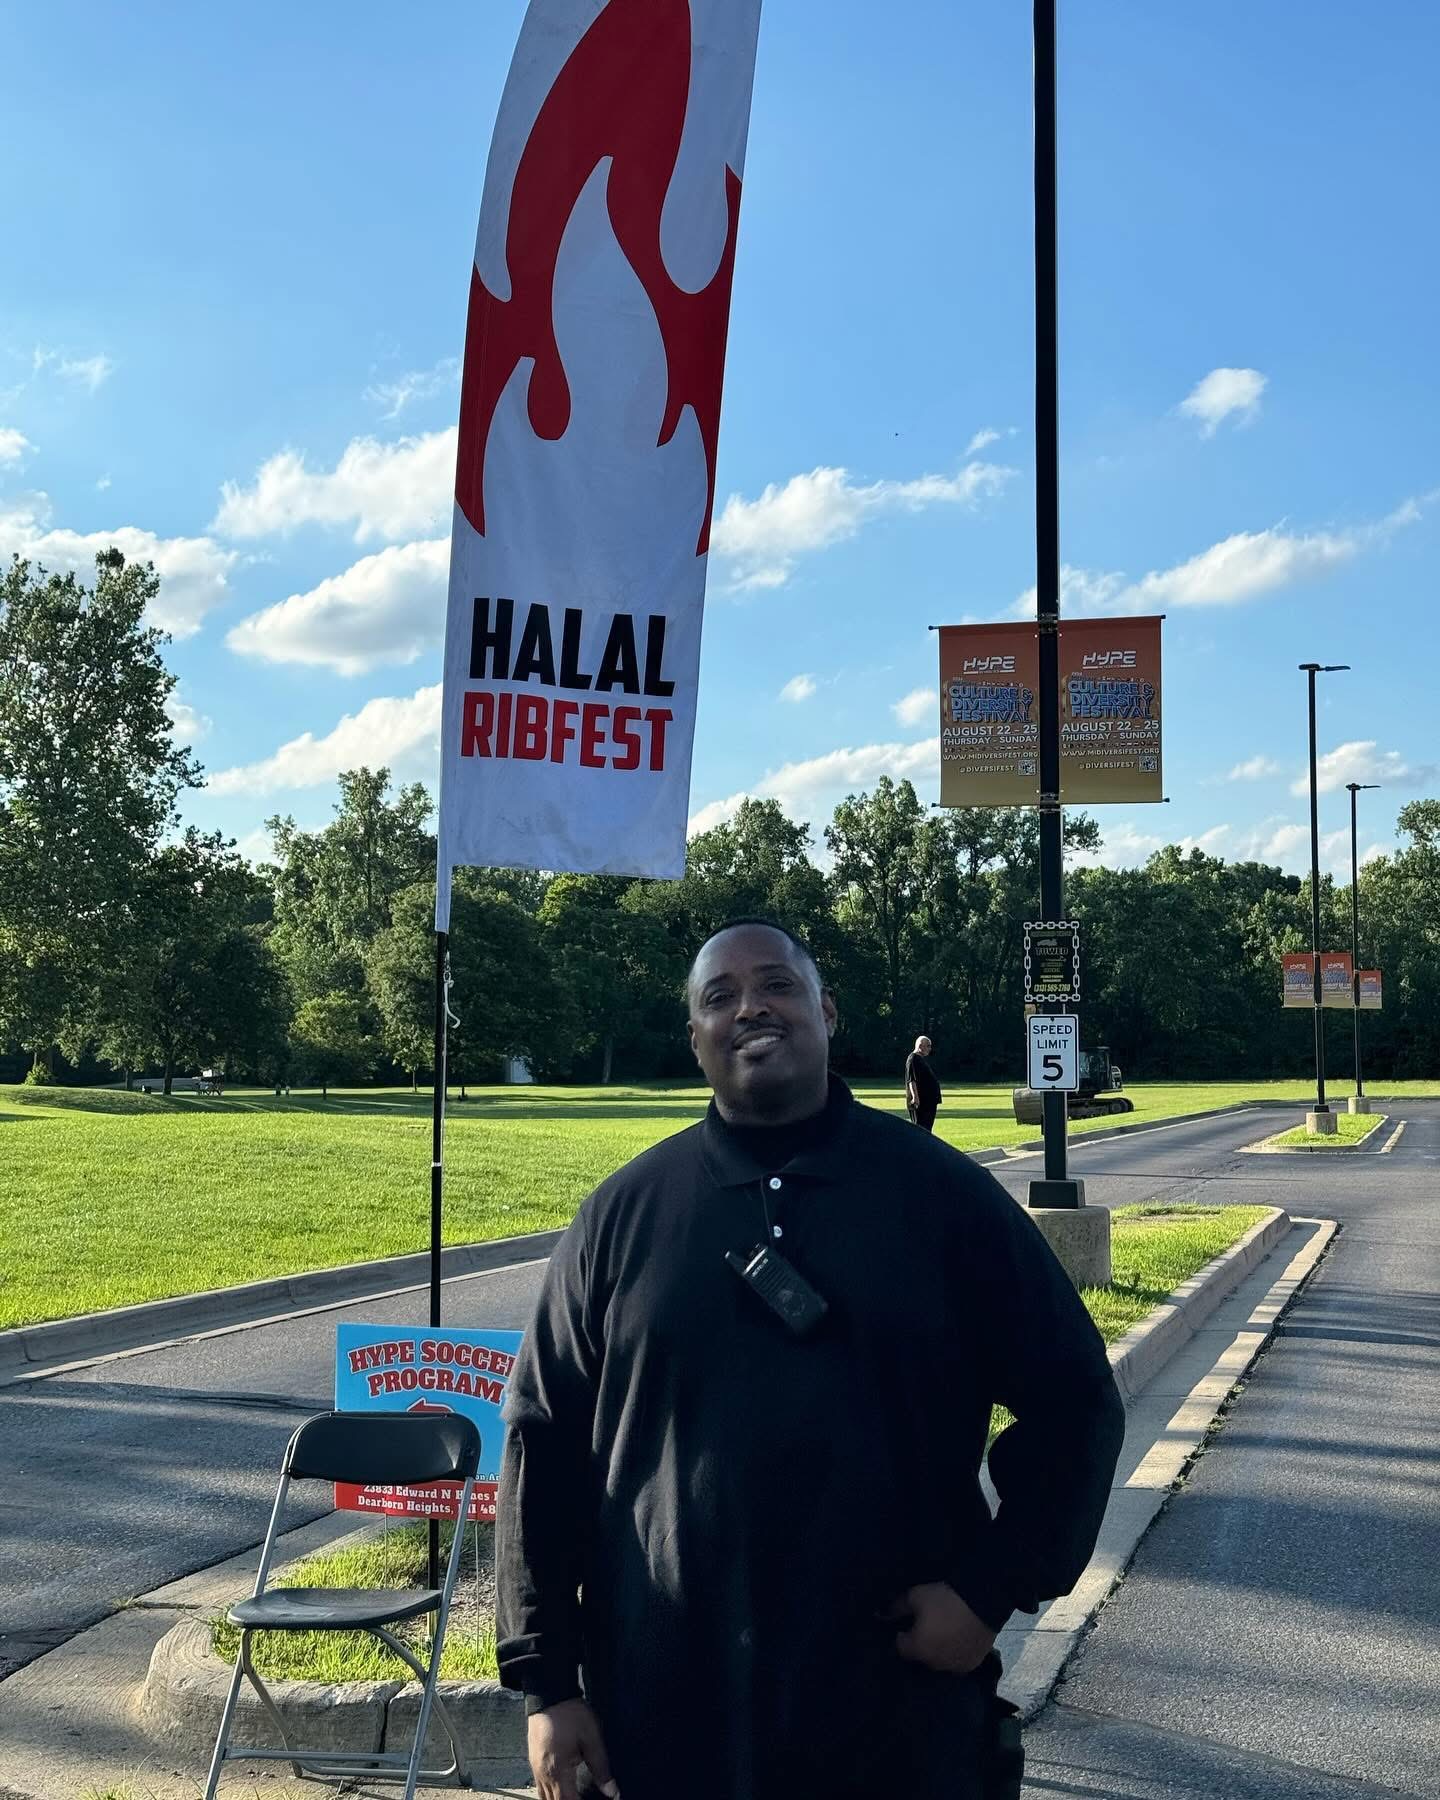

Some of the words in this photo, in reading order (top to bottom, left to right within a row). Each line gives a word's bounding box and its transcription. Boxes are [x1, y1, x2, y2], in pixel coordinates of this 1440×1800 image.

[469, 597, 675, 697] HALAL
[963, 656, 1016, 671] HYPE
[1082, 651, 1136, 666] HYPE
[949, 685, 1019, 700] CULTURE
[1021, 688, 1033, 700] &
[1068, 680, 1138, 694] CULTURE
[1142, 683, 1154, 695] &
[951, 698, 1032, 711] DIVERSITY
[1070, 693, 1153, 706] DIVERSITY
[952, 710, 1030, 723] FESTIVAL
[1071, 706, 1152, 719] FESTIVAL
[460, 691, 674, 772] RIBFEST
[943, 726, 994, 737] AUGUST
[997, 726, 1011, 735] 22
[1023, 724, 1038, 734] 25
[1061, 721, 1114, 732] AUGUST
[1117, 721, 1131, 730] 22
[1144, 720, 1159, 730] 25
[944, 737, 991, 745] THURSDAY
[1000, 736, 1038, 744] SUNDAY
[1061, 732, 1110, 742] THURSDAY
[1120, 731, 1160, 740] SUNDAY
[1032, 1024, 1073, 1035] SPEED
[1036, 1039, 1069, 1050] LIMIT
[1042, 1054, 1064, 1082] 5
[348, 1340, 415, 1374] HYPE
[367, 1367, 505, 1406] PROGRAM
[396, 1485, 438, 1499] Edward
[441, 1490, 451, 1500] N
[455, 1490, 490, 1501] Hnes
[358, 1495, 404, 1511] Dearborn
[406, 1499, 454, 1515] Heights,
